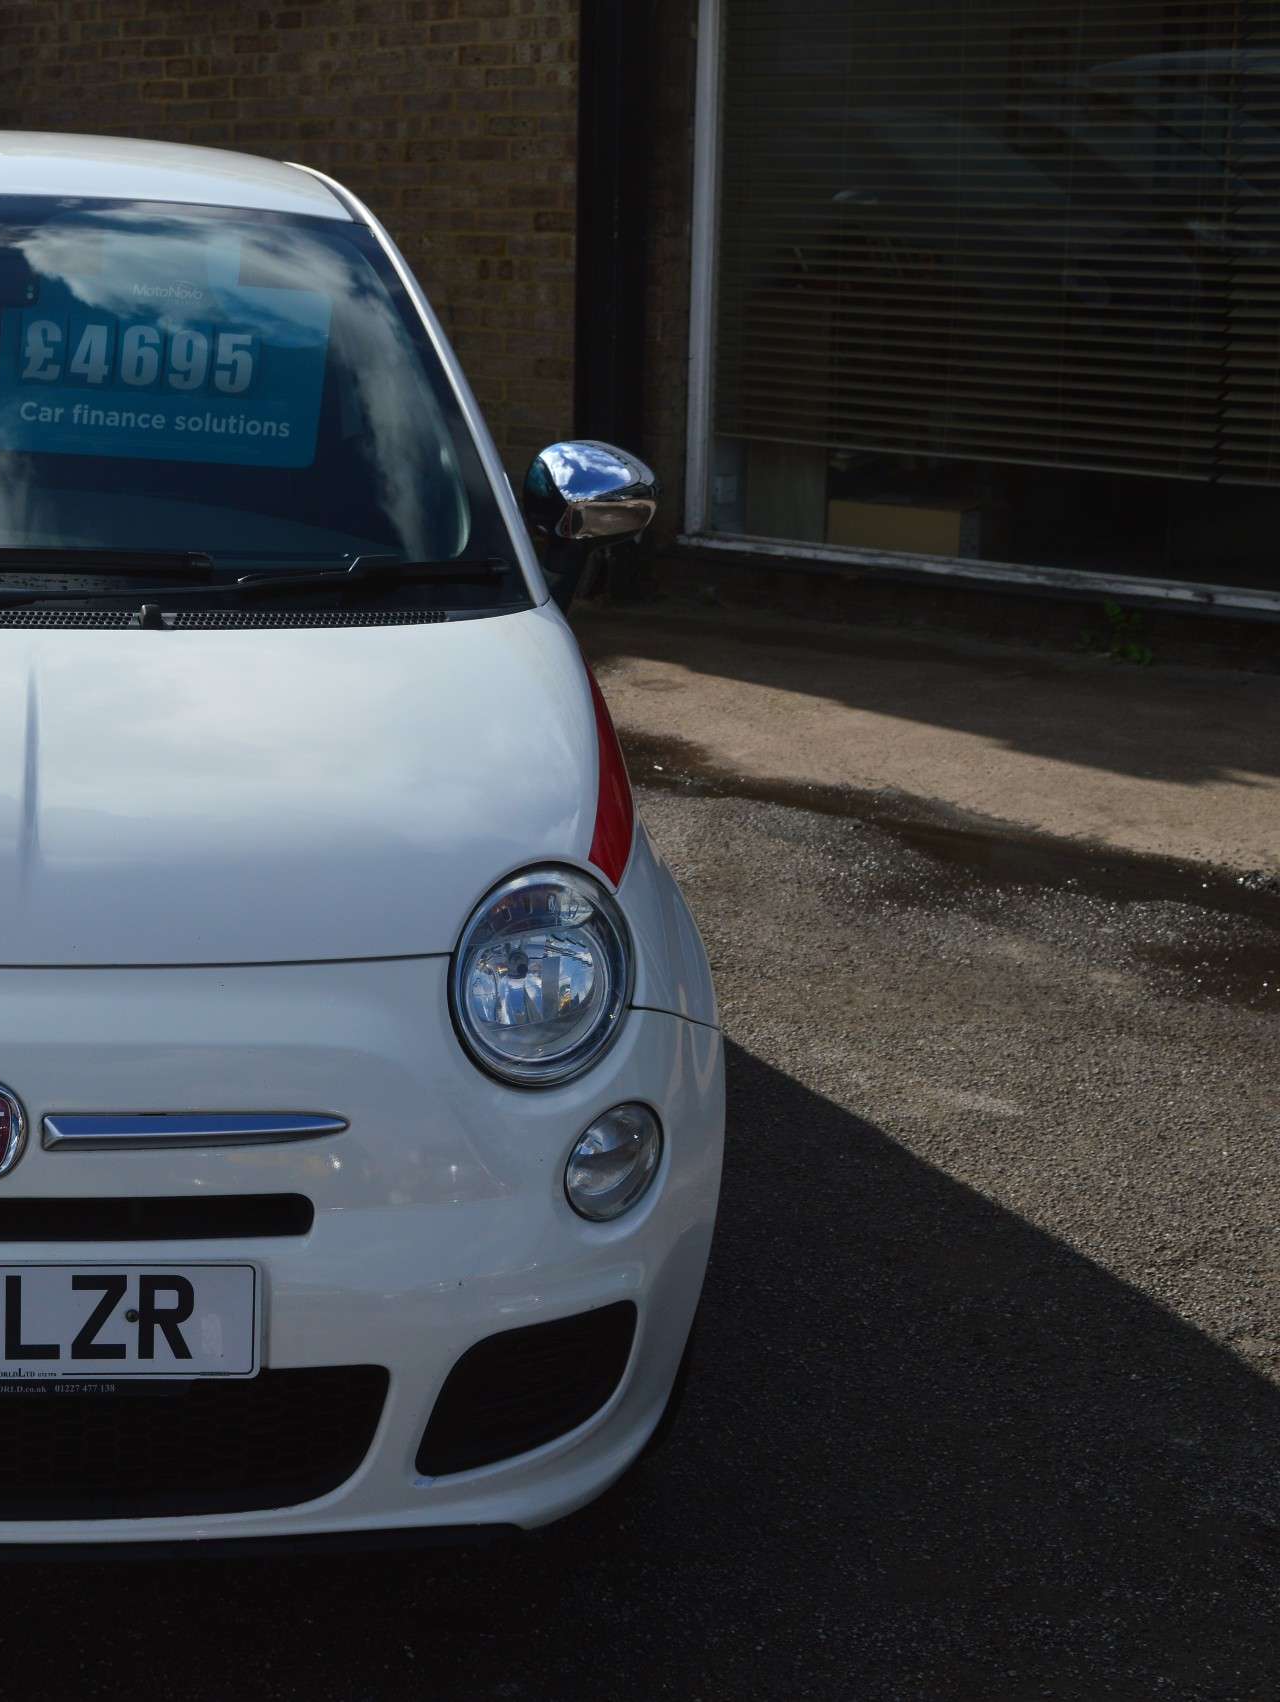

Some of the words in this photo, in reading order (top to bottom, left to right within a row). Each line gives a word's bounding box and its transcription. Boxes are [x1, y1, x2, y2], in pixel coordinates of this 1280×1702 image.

[22, 319, 253, 393] £4695
[20, 402, 64, 424] Car
[73, 404, 166, 430] finance
[174, 414, 290, 437] solutions
[5, 1275, 195, 1360] LZR
